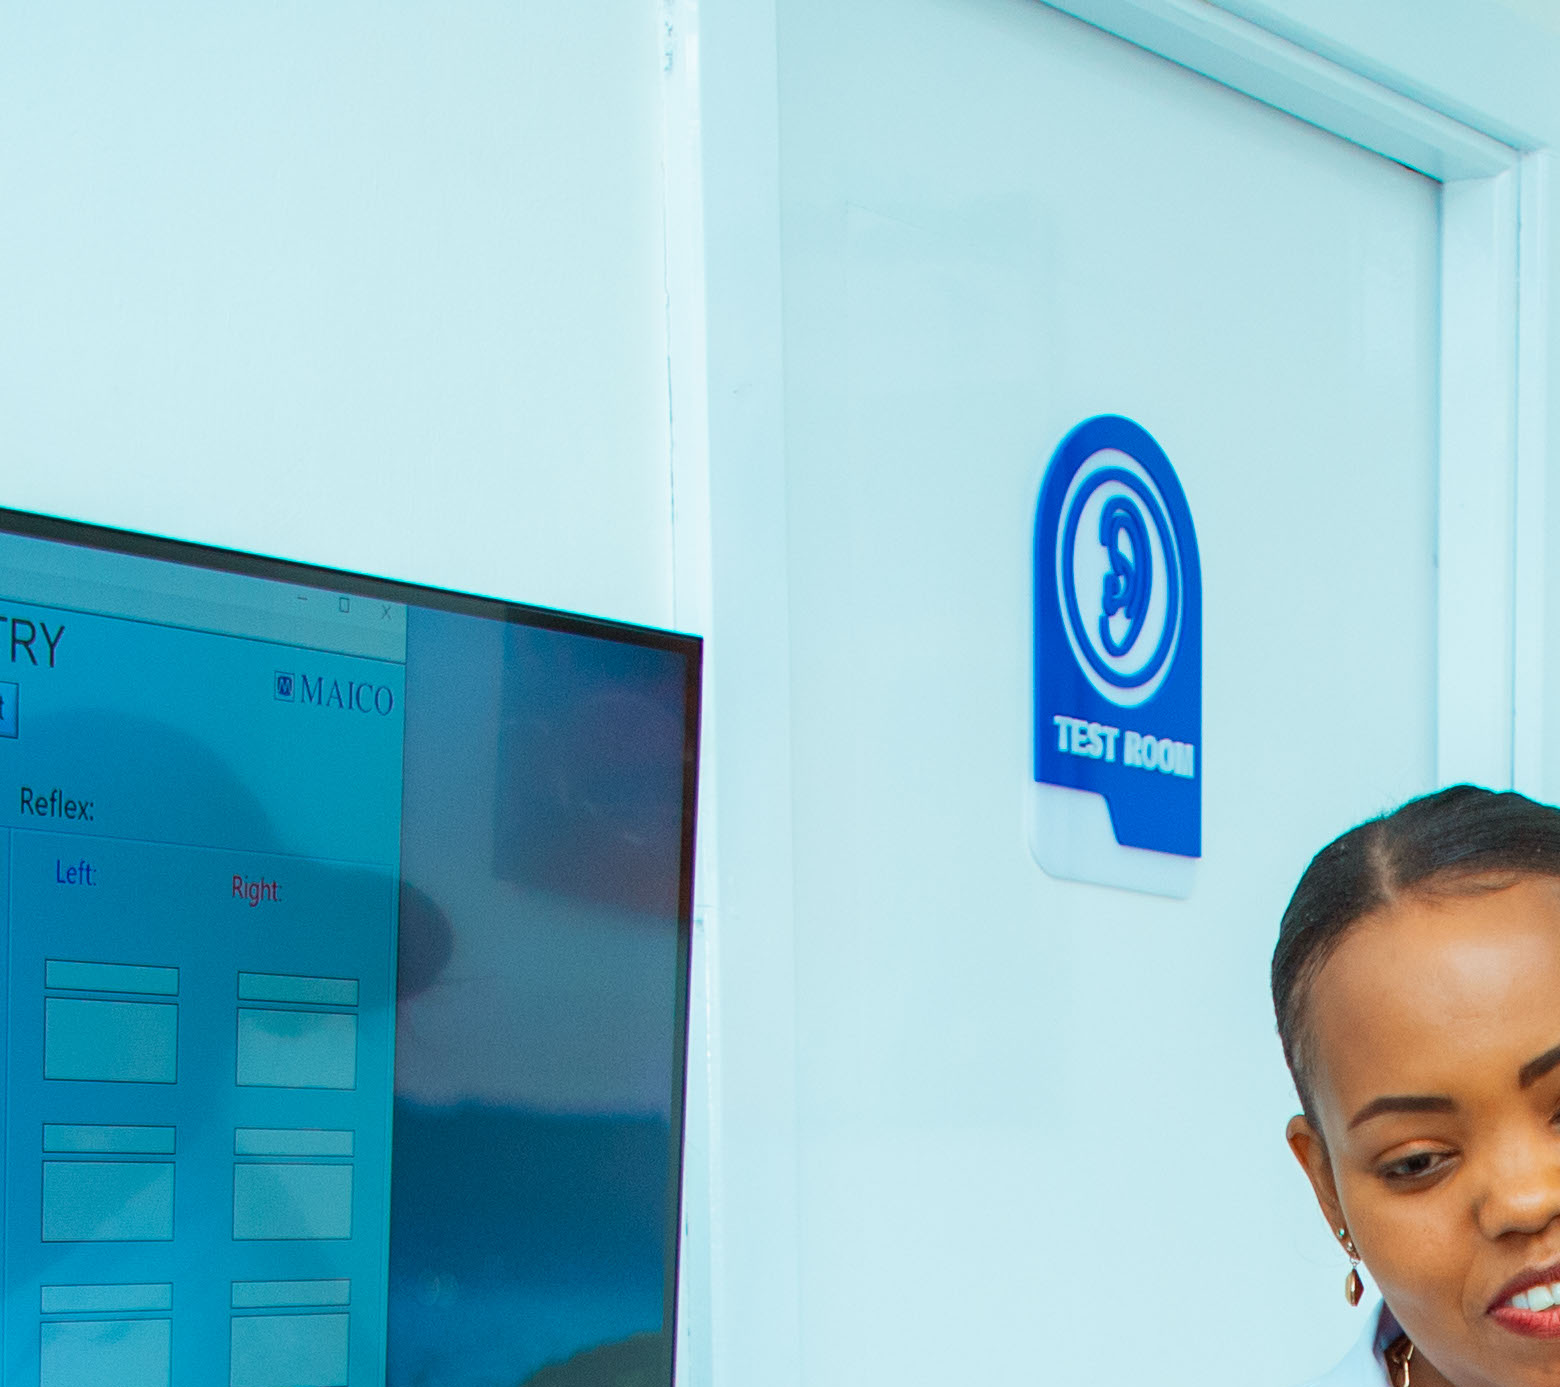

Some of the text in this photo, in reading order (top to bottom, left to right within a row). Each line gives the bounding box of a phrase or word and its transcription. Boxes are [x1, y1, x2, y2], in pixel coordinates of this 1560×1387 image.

[299, 673, 395, 717] MAICO
[1053, 716, 1195, 779] TEST ROOM
[19, 786, 96, 822] Reflex:
[55, 858, 98, 887] Left:
[231, 874, 283, 908] Right:
